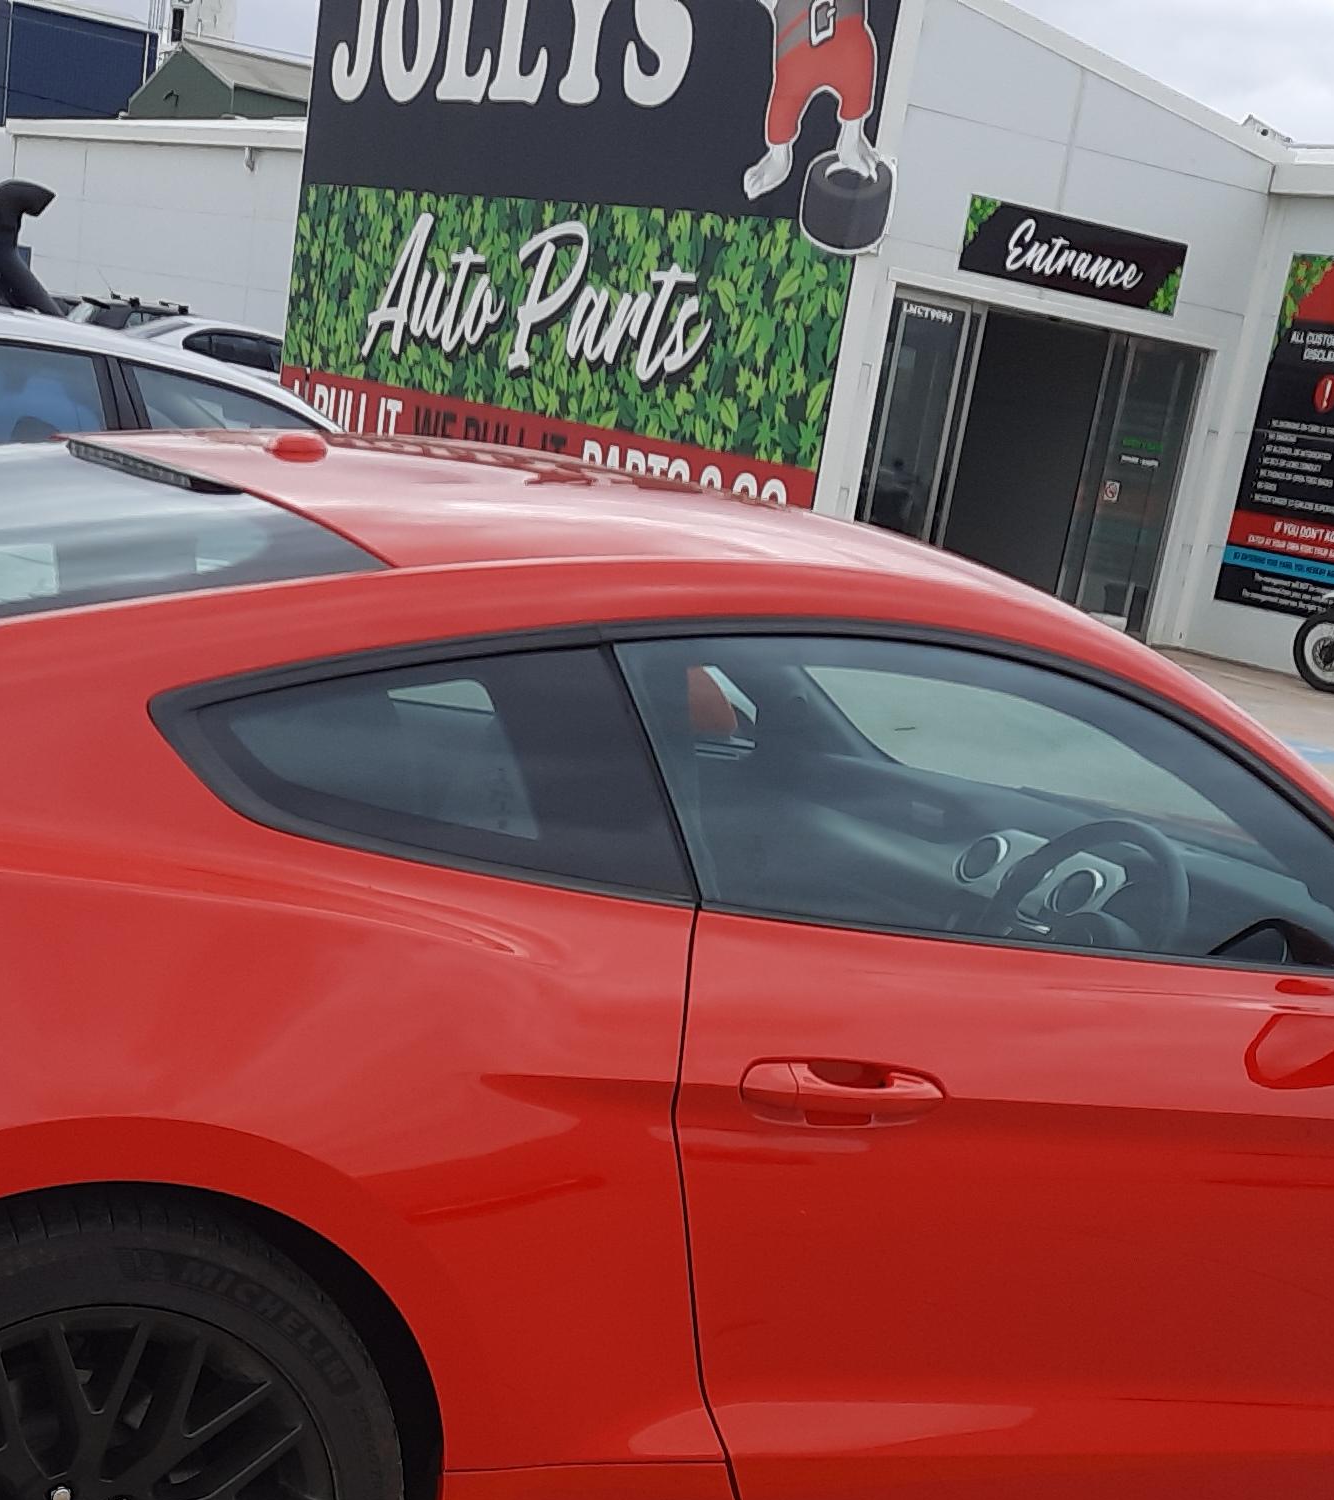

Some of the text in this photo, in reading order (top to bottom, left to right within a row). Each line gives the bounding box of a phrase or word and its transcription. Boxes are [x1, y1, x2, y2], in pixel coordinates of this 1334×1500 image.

[331, 0, 694, 105] JOLLYS
[361, 212, 712, 383] Auto Parts
[1005, 218, 1144, 290] Entrance
[1290, 331, 1304, 344] ALL
[1284, 523, 1299, 536] YOU
[1300, 525, 1324, 541] DON'T
[181, 1258, 353, 1388] MICHELIN
